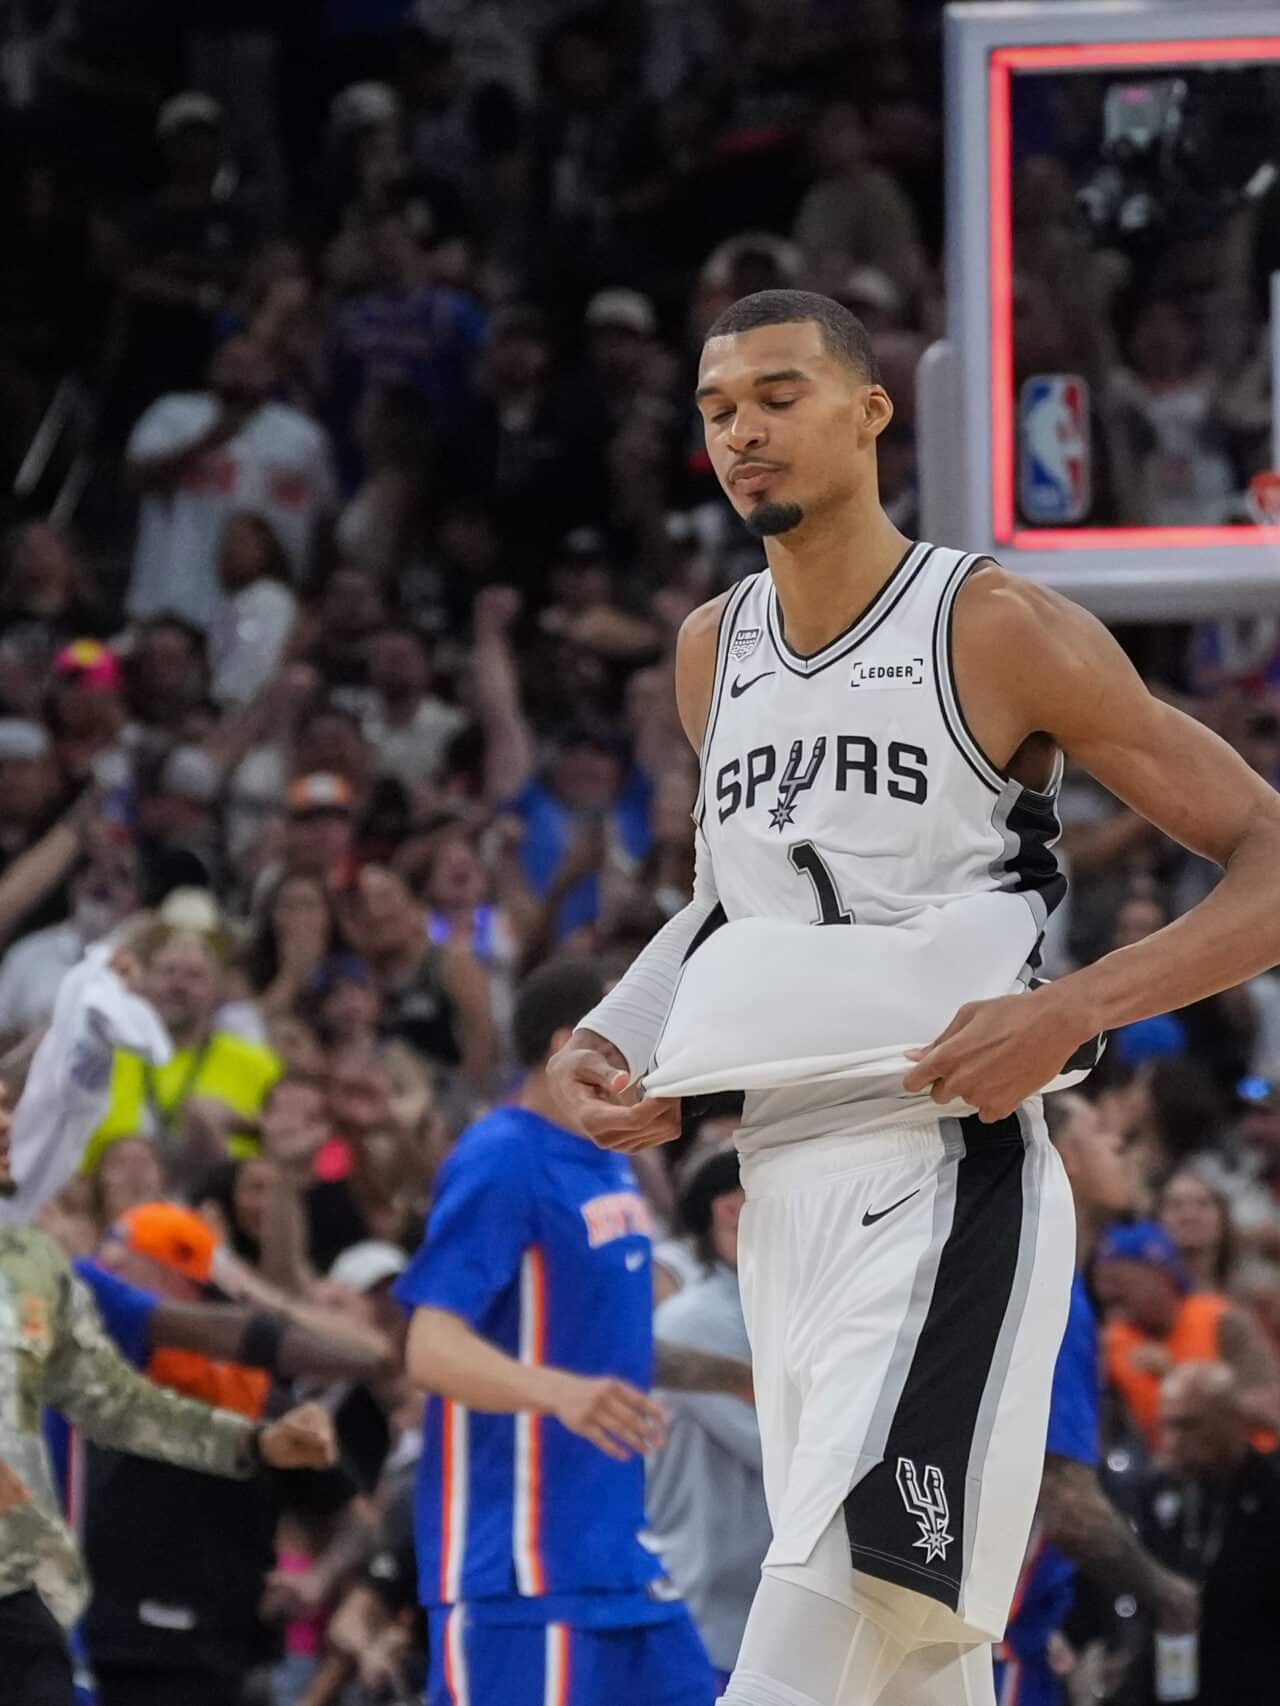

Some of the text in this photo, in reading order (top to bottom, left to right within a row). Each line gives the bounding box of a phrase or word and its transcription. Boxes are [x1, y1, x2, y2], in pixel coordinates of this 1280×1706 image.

[860, 665, 913, 680] LEDGER
[716, 735, 928, 833] SPURS
[788, 839, 855, 925] 1
